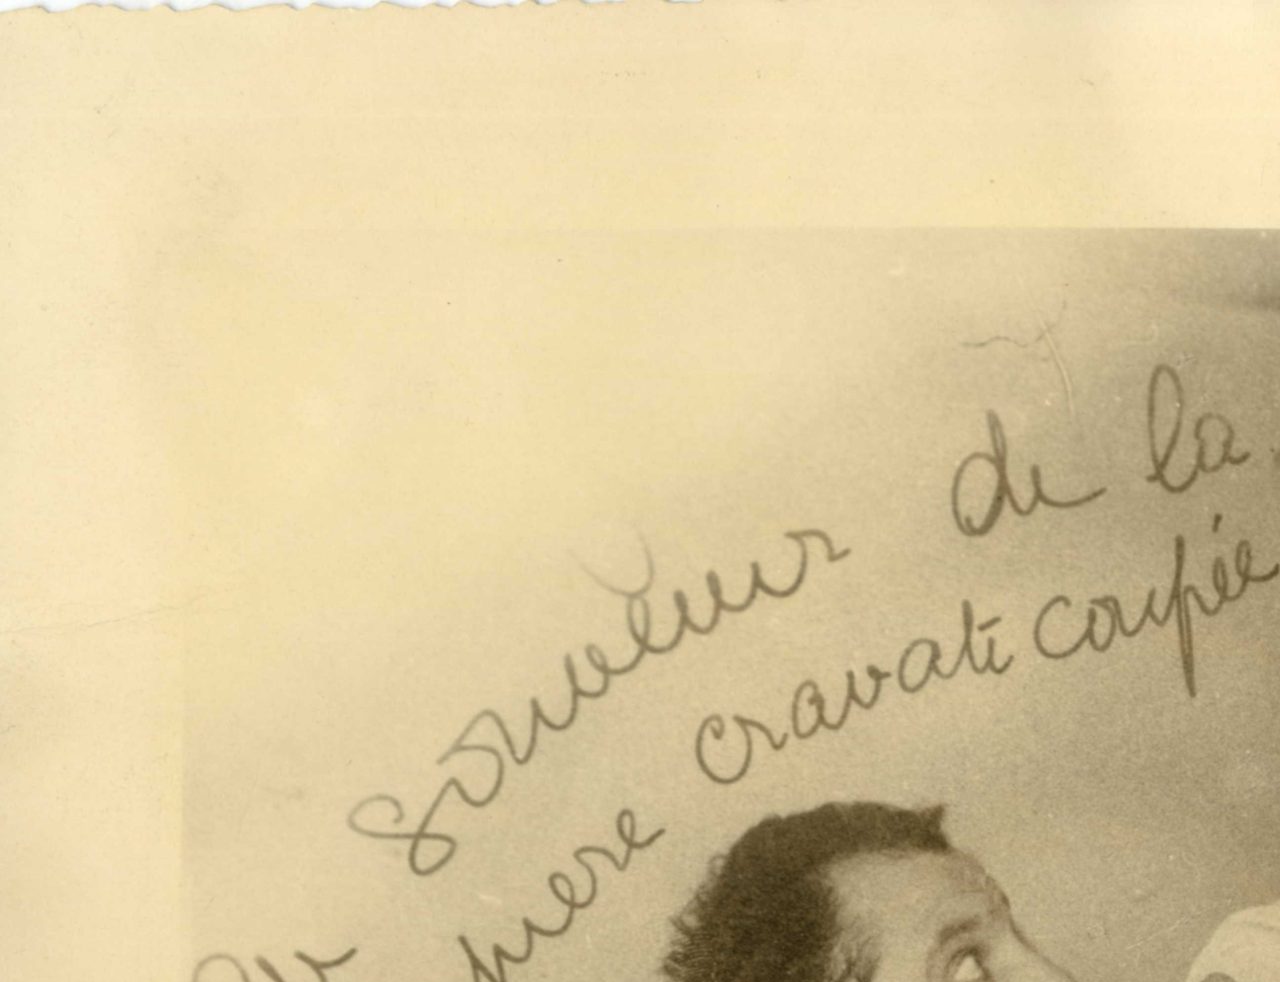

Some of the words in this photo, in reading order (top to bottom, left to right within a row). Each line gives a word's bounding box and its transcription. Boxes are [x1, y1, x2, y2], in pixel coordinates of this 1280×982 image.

[951, 410, 1106, 537] de
[1145, 364, 1251, 493] la
[1033, 514, 1280, 697] coupée
